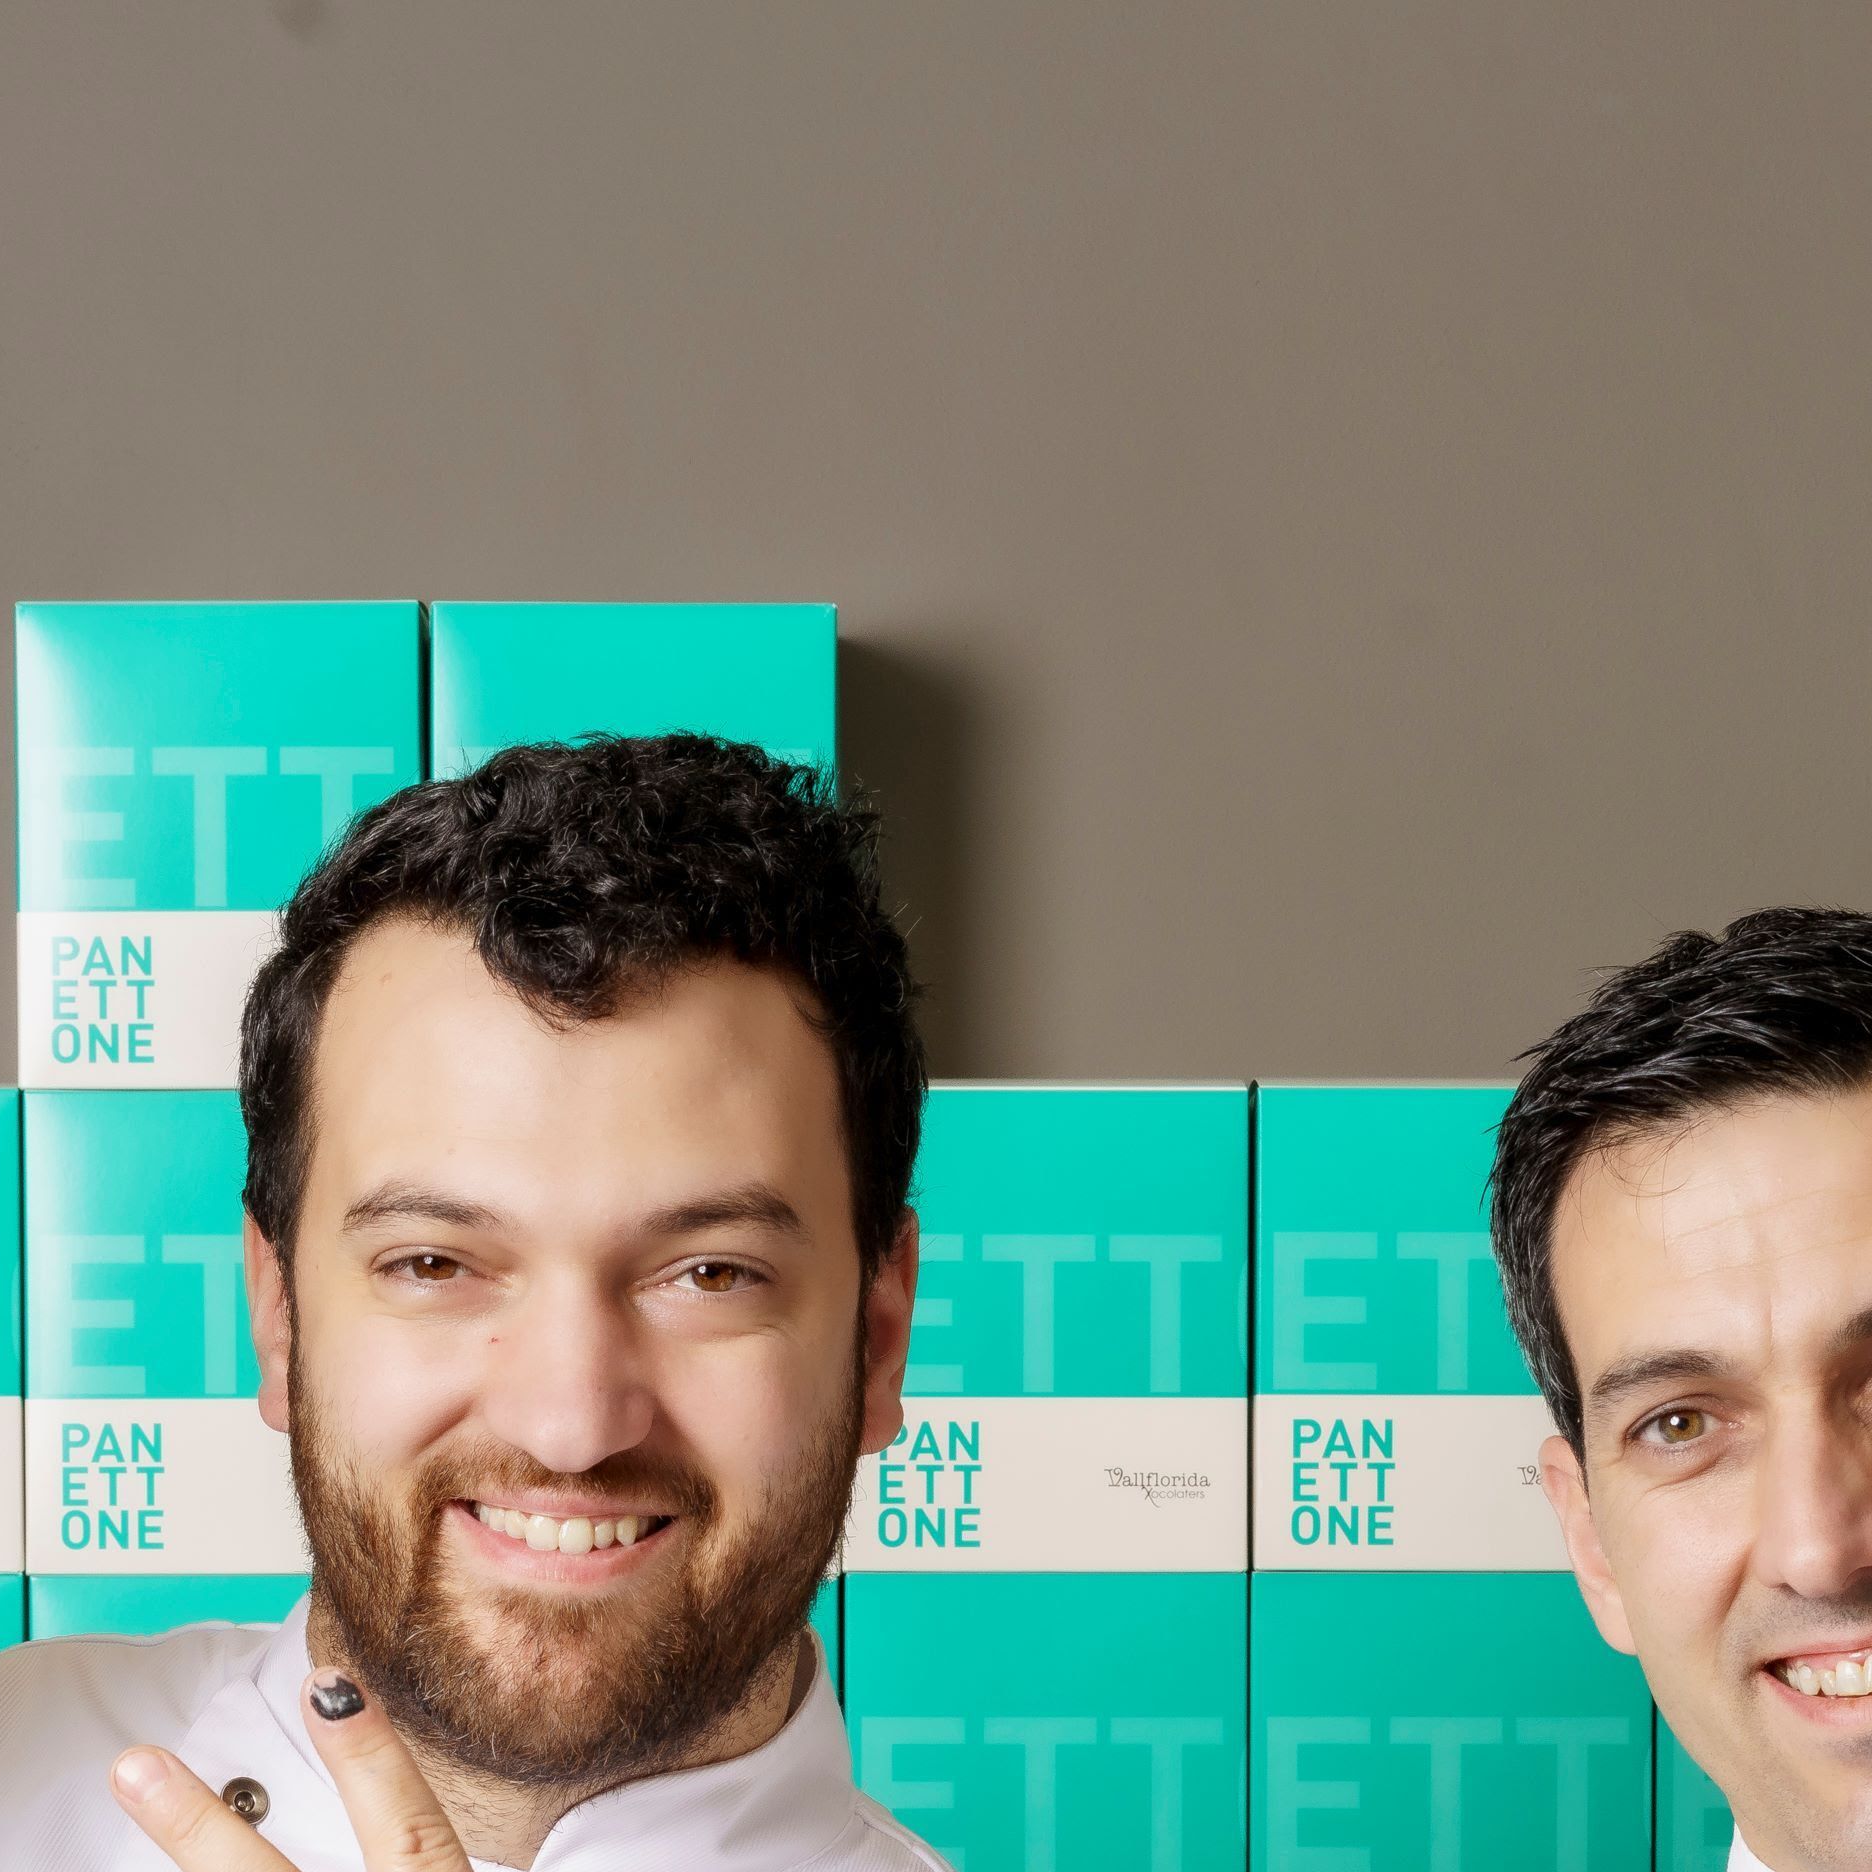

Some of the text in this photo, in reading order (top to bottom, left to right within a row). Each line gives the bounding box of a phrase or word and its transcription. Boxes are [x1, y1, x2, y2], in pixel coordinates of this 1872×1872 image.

[31, 748, 394, 907] ETT
[52, 936, 152, 975] PAN
[52, 980, 154, 1019] ETT
[51, 1023, 154, 1063] ONE
[40, 1235, 243, 1394] ET
[1273, 1232, 1493, 1391] ET
[62, 1424, 162, 1463] PAN
[1294, 1419, 1393, 1458] PAN
[62, 1467, 164, 1506] ETT
[879, 1465, 982, 1504] ETT
[1104, 1467, 1210, 1488] Vallflorida
[1141, 1486, 1205, 1508] Xocolaters
[1293, 1462, 1396, 1501] ETT
[61, 1511, 164, 1550] ONE
[878, 1508, 981, 1547] ONE
[1291, 1505, 1394, 1545] ONE
